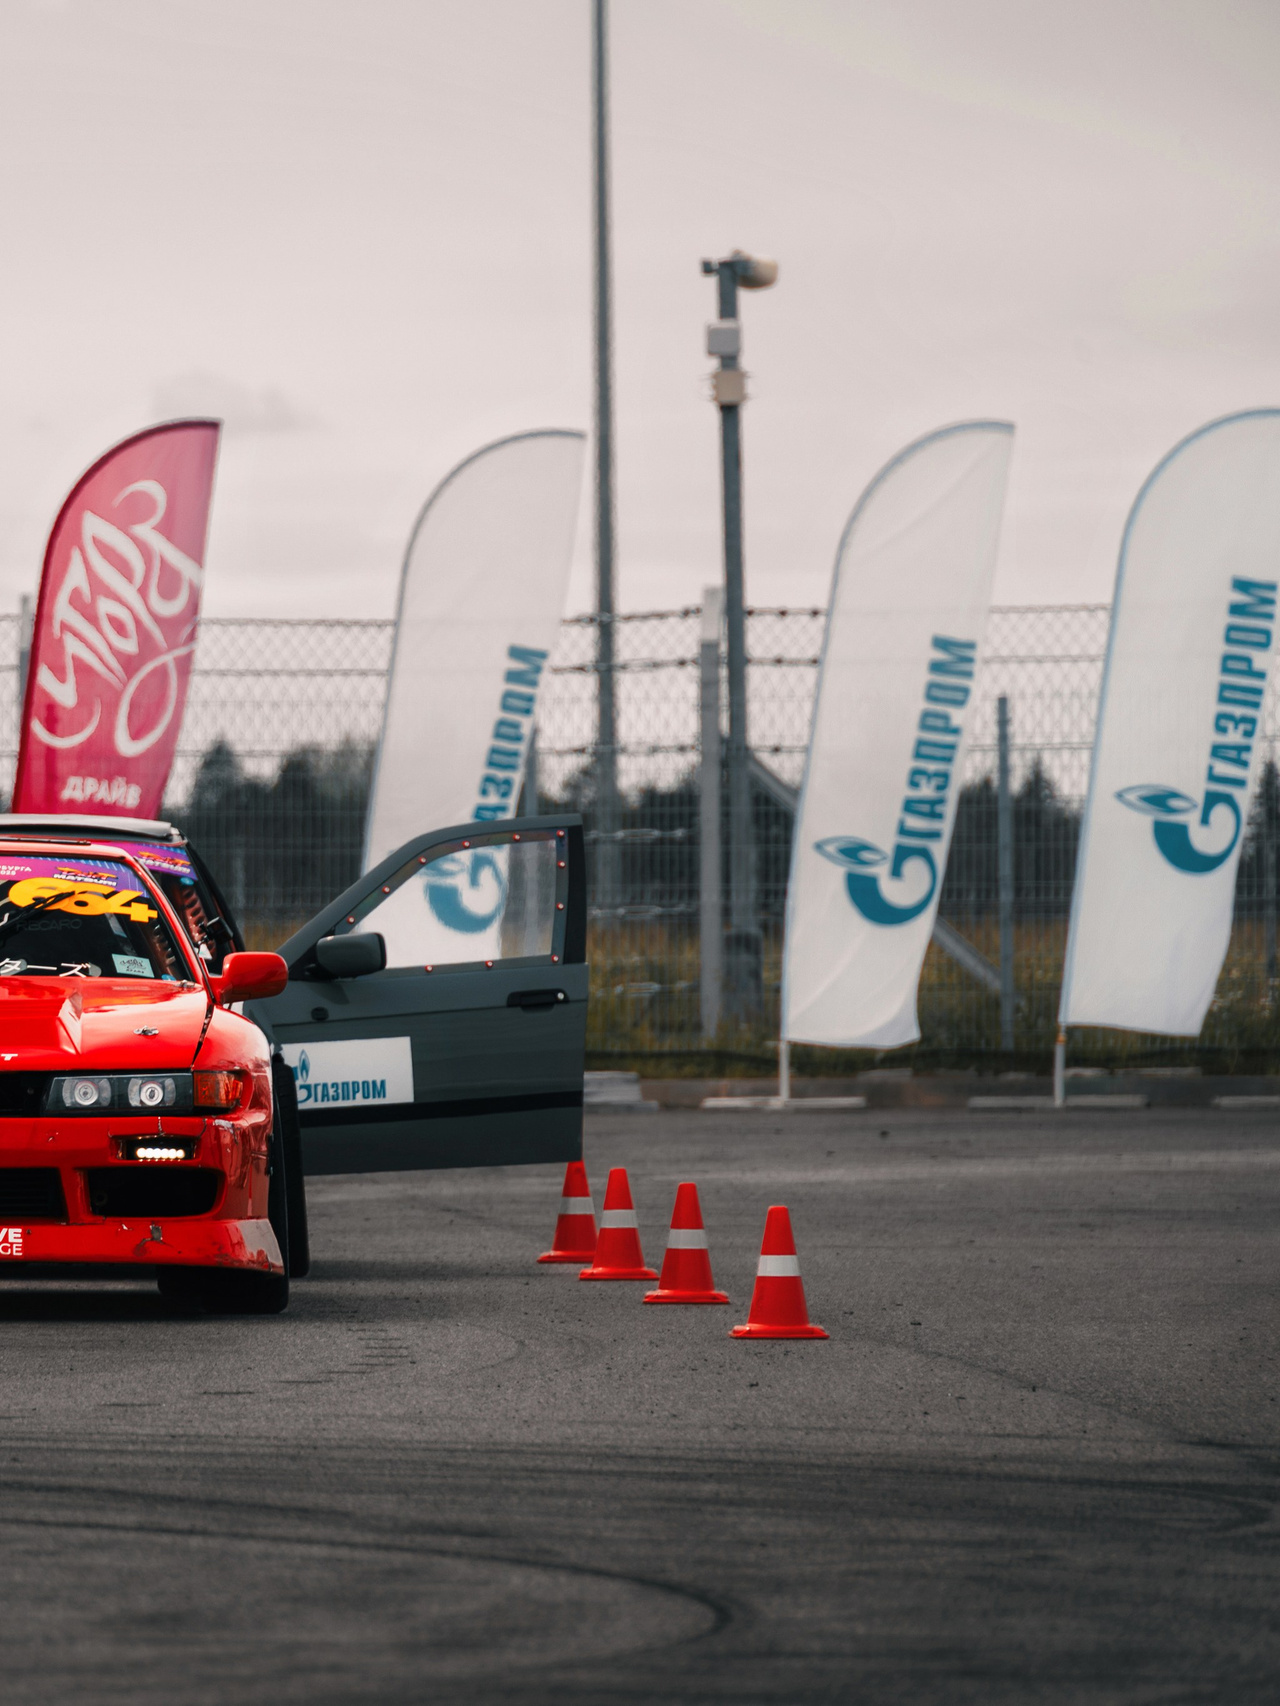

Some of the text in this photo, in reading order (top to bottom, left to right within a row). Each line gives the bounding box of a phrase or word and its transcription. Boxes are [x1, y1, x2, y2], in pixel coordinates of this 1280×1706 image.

[473, 645, 549, 822] АЗПРОМ
[898, 635, 976, 842] ГАЗПРОМ
[1207, 575, 1277, 789] ГАЗПРОМ
[60, 776, 141, 808] ДРАЙВ
[313, 1079, 387, 1103] ГАЗПРОМ
